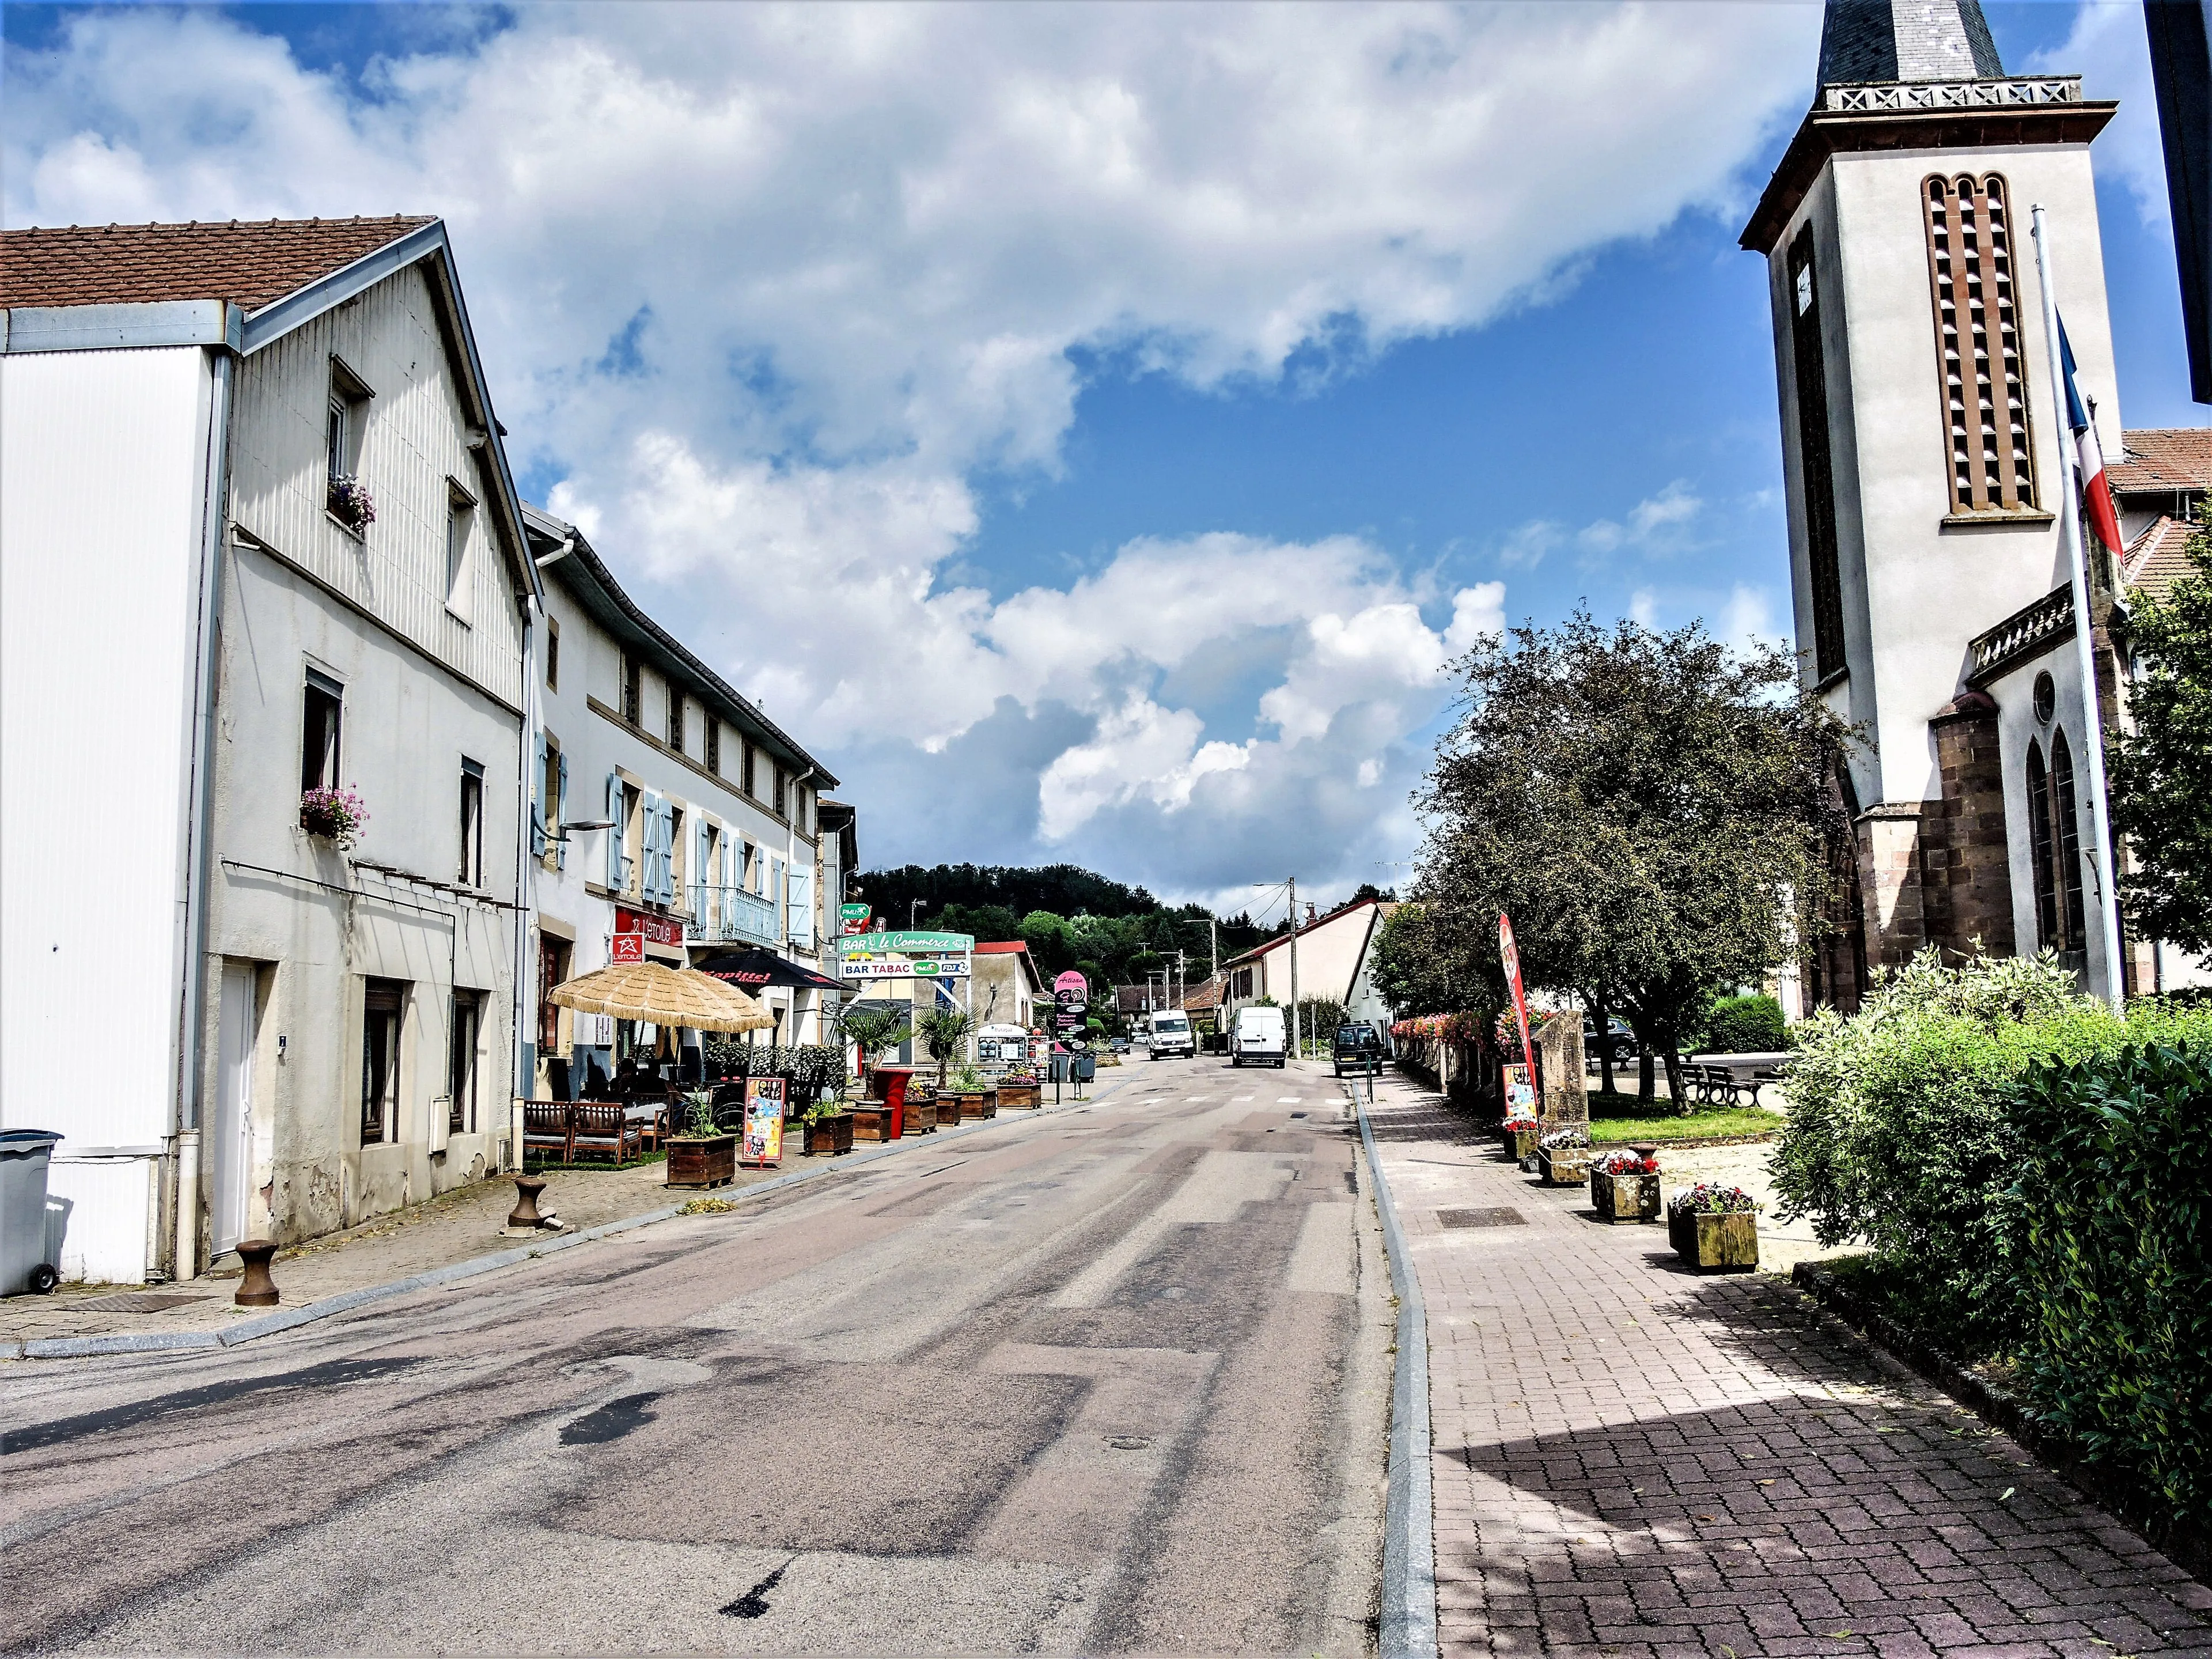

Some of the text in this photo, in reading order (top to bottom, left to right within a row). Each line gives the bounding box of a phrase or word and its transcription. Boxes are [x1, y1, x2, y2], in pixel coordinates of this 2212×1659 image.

[842, 933, 949, 950] BAR le Commerce
[846, 965, 869, 975] BAR
[872, 965, 910, 973] TABAC
